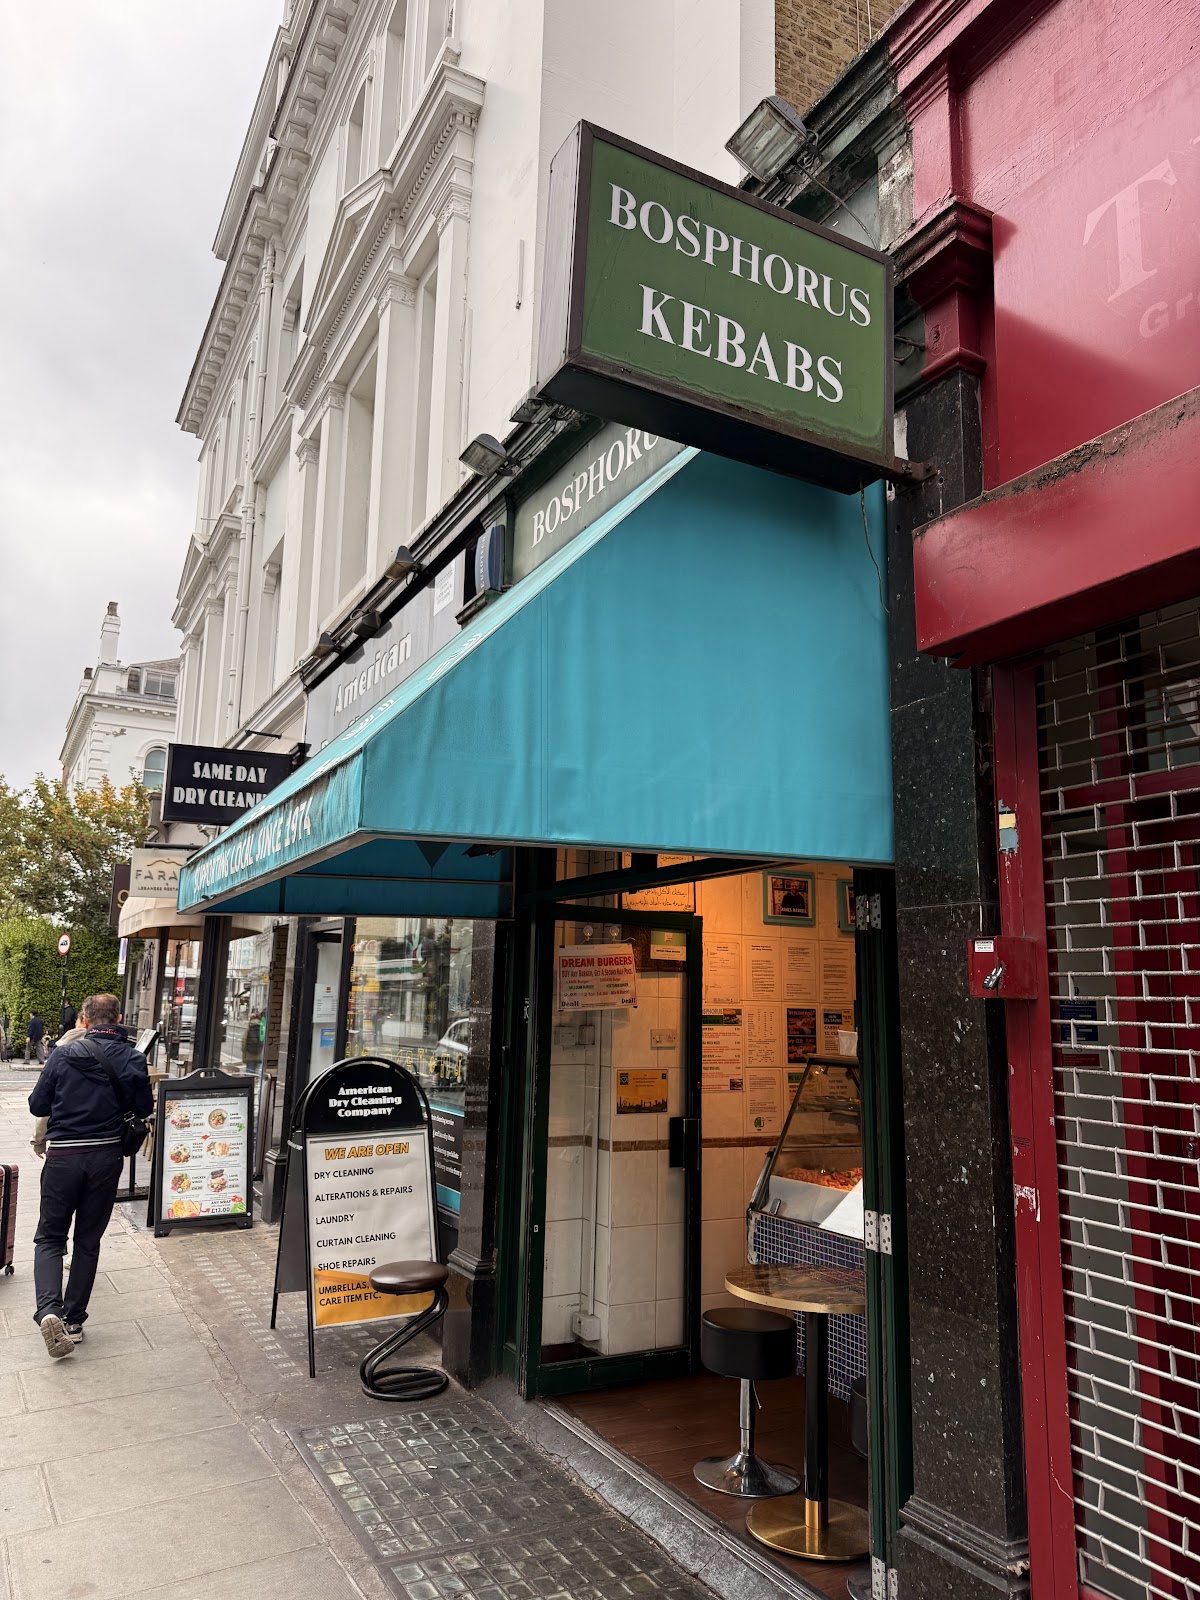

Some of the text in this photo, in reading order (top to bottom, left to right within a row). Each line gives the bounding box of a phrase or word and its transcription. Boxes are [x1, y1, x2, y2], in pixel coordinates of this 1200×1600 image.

[1083, 135, 1200, 302] T
[607, 181, 872, 328] BOSPHORUS
[1138, 289, 1200, 339] Gr
[636, 283, 845, 404] KEBABS
[334, 632, 413, 716] American
[192, 761, 268, 784] SAME DAY
[172, 786, 208, 805] DRY
[193, 849, 230, 894] SUPPORTING
[230, 833, 254, 875] LOCAL
[255, 815, 284, 862] SINCE
[284, 796, 314, 847] 1974
[561, 956, 633, 968] DREAM BURGERS
[337, 1085, 393, 1096] American
[328, 1094, 402, 1108] Dry Cleaning
[337, 1105, 393, 1117] Company
[324, 1142, 409, 1161] WE ARE OPEN
[314, 1167, 374, 1180] DRY CLEANING
[314, 1185, 413, 1202] ALTERATIONS & REPAIRS
[315, 1214, 355, 1225] LAUNDRY
[316, 1231, 396, 1248] CURTAIN CLEANING
[317, 1257, 376, 1271] SHOE REPAIRS
[318, 1281, 370, 1295] UMBRELLAS,
[319, 1292, 382, 1307] CARE ITEM ETC.
